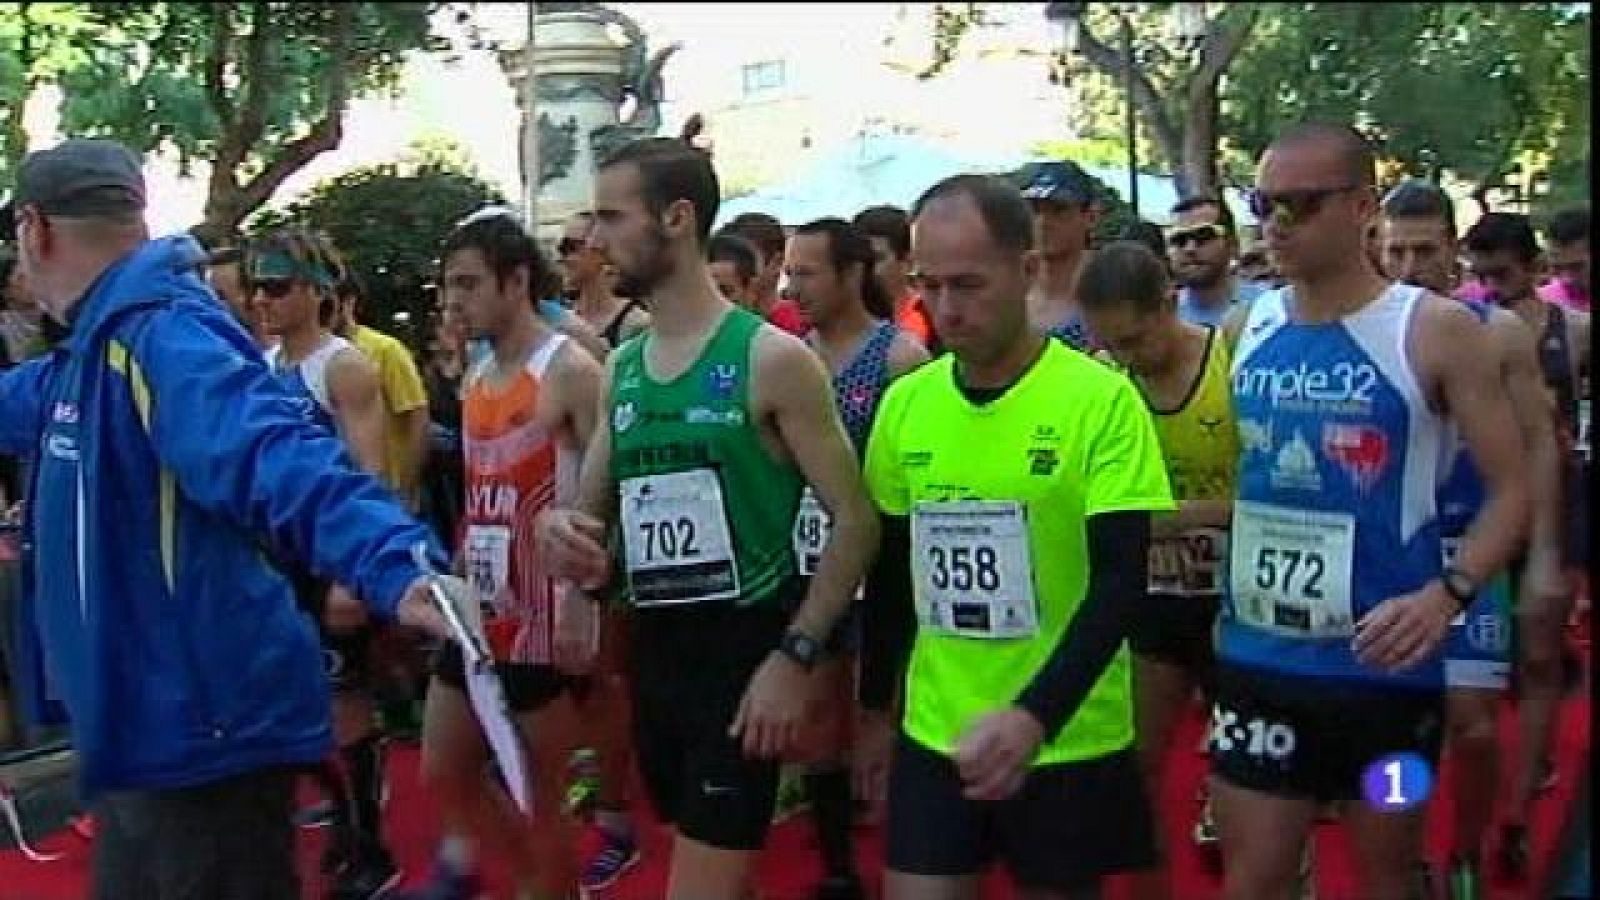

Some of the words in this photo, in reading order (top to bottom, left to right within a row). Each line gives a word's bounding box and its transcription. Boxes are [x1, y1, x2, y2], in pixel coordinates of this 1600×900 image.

[638, 517, 699, 561] 702
[928, 546, 1000, 591] 358
[1256, 547, 1323, 599] 572
